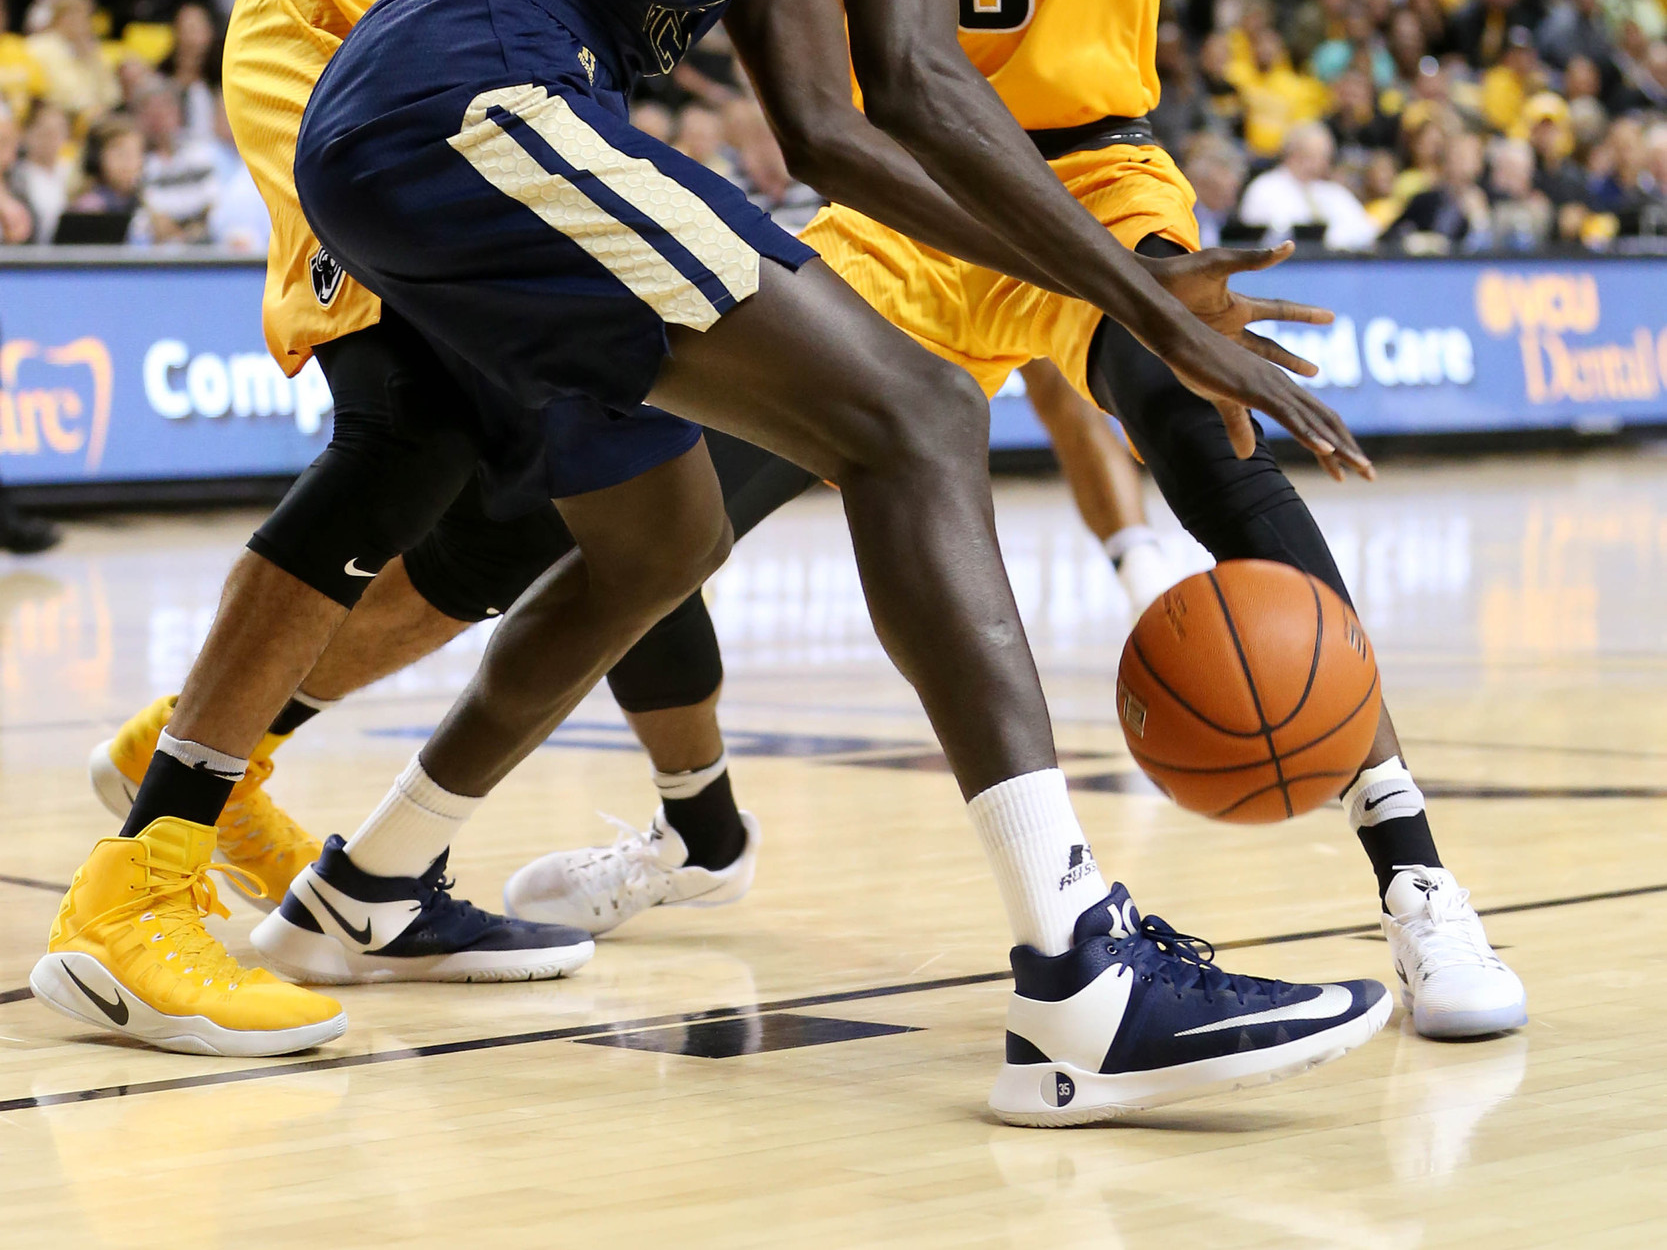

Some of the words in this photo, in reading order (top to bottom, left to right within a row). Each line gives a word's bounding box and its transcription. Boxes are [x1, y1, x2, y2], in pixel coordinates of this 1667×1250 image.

[1363, 315, 1476, 387] Care
[1520, 324, 1660, 405] Dental
[1057, 1082, 1071, 1097] 35
